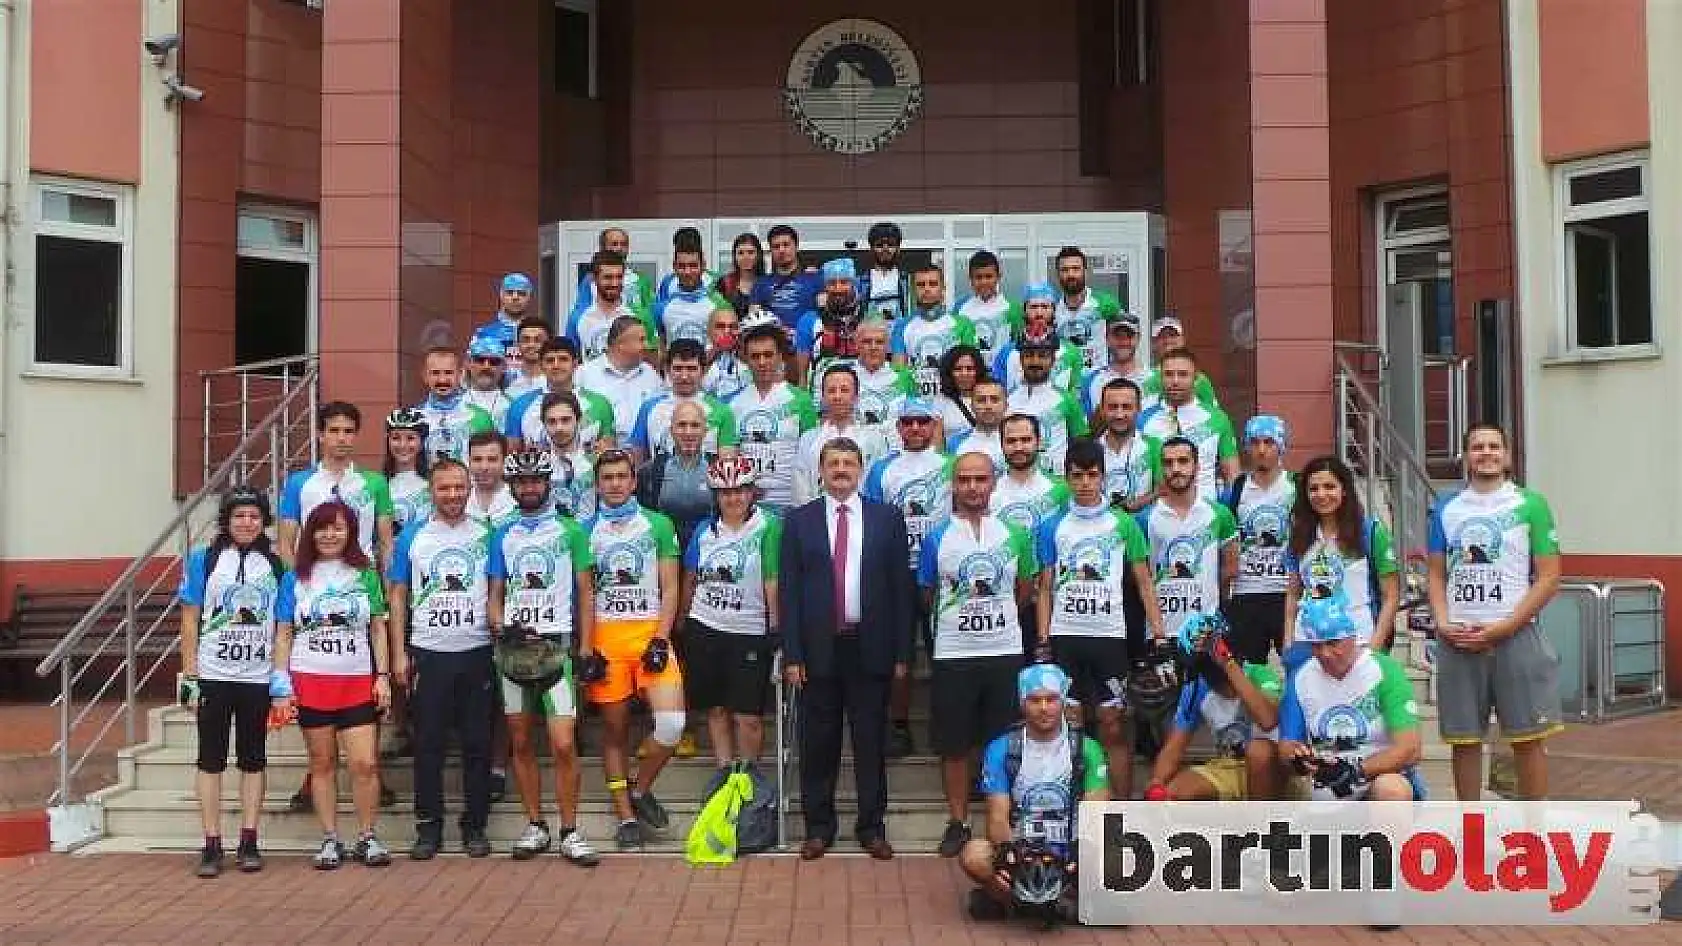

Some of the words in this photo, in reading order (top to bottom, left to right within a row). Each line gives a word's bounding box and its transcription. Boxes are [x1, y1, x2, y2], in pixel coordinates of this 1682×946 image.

[1454, 583, 1502, 602] 2014
[605, 600, 648, 613] 2014
[1064, 596, 1111, 615] 2014
[1159, 596, 1202, 613] 2014
[428, 609, 476, 627] 2014
[510, 607, 555, 623] 2014
[958, 614, 1006, 632] 2014
[217, 642, 266, 661] 2014
[308, 638, 356, 655] 2014
